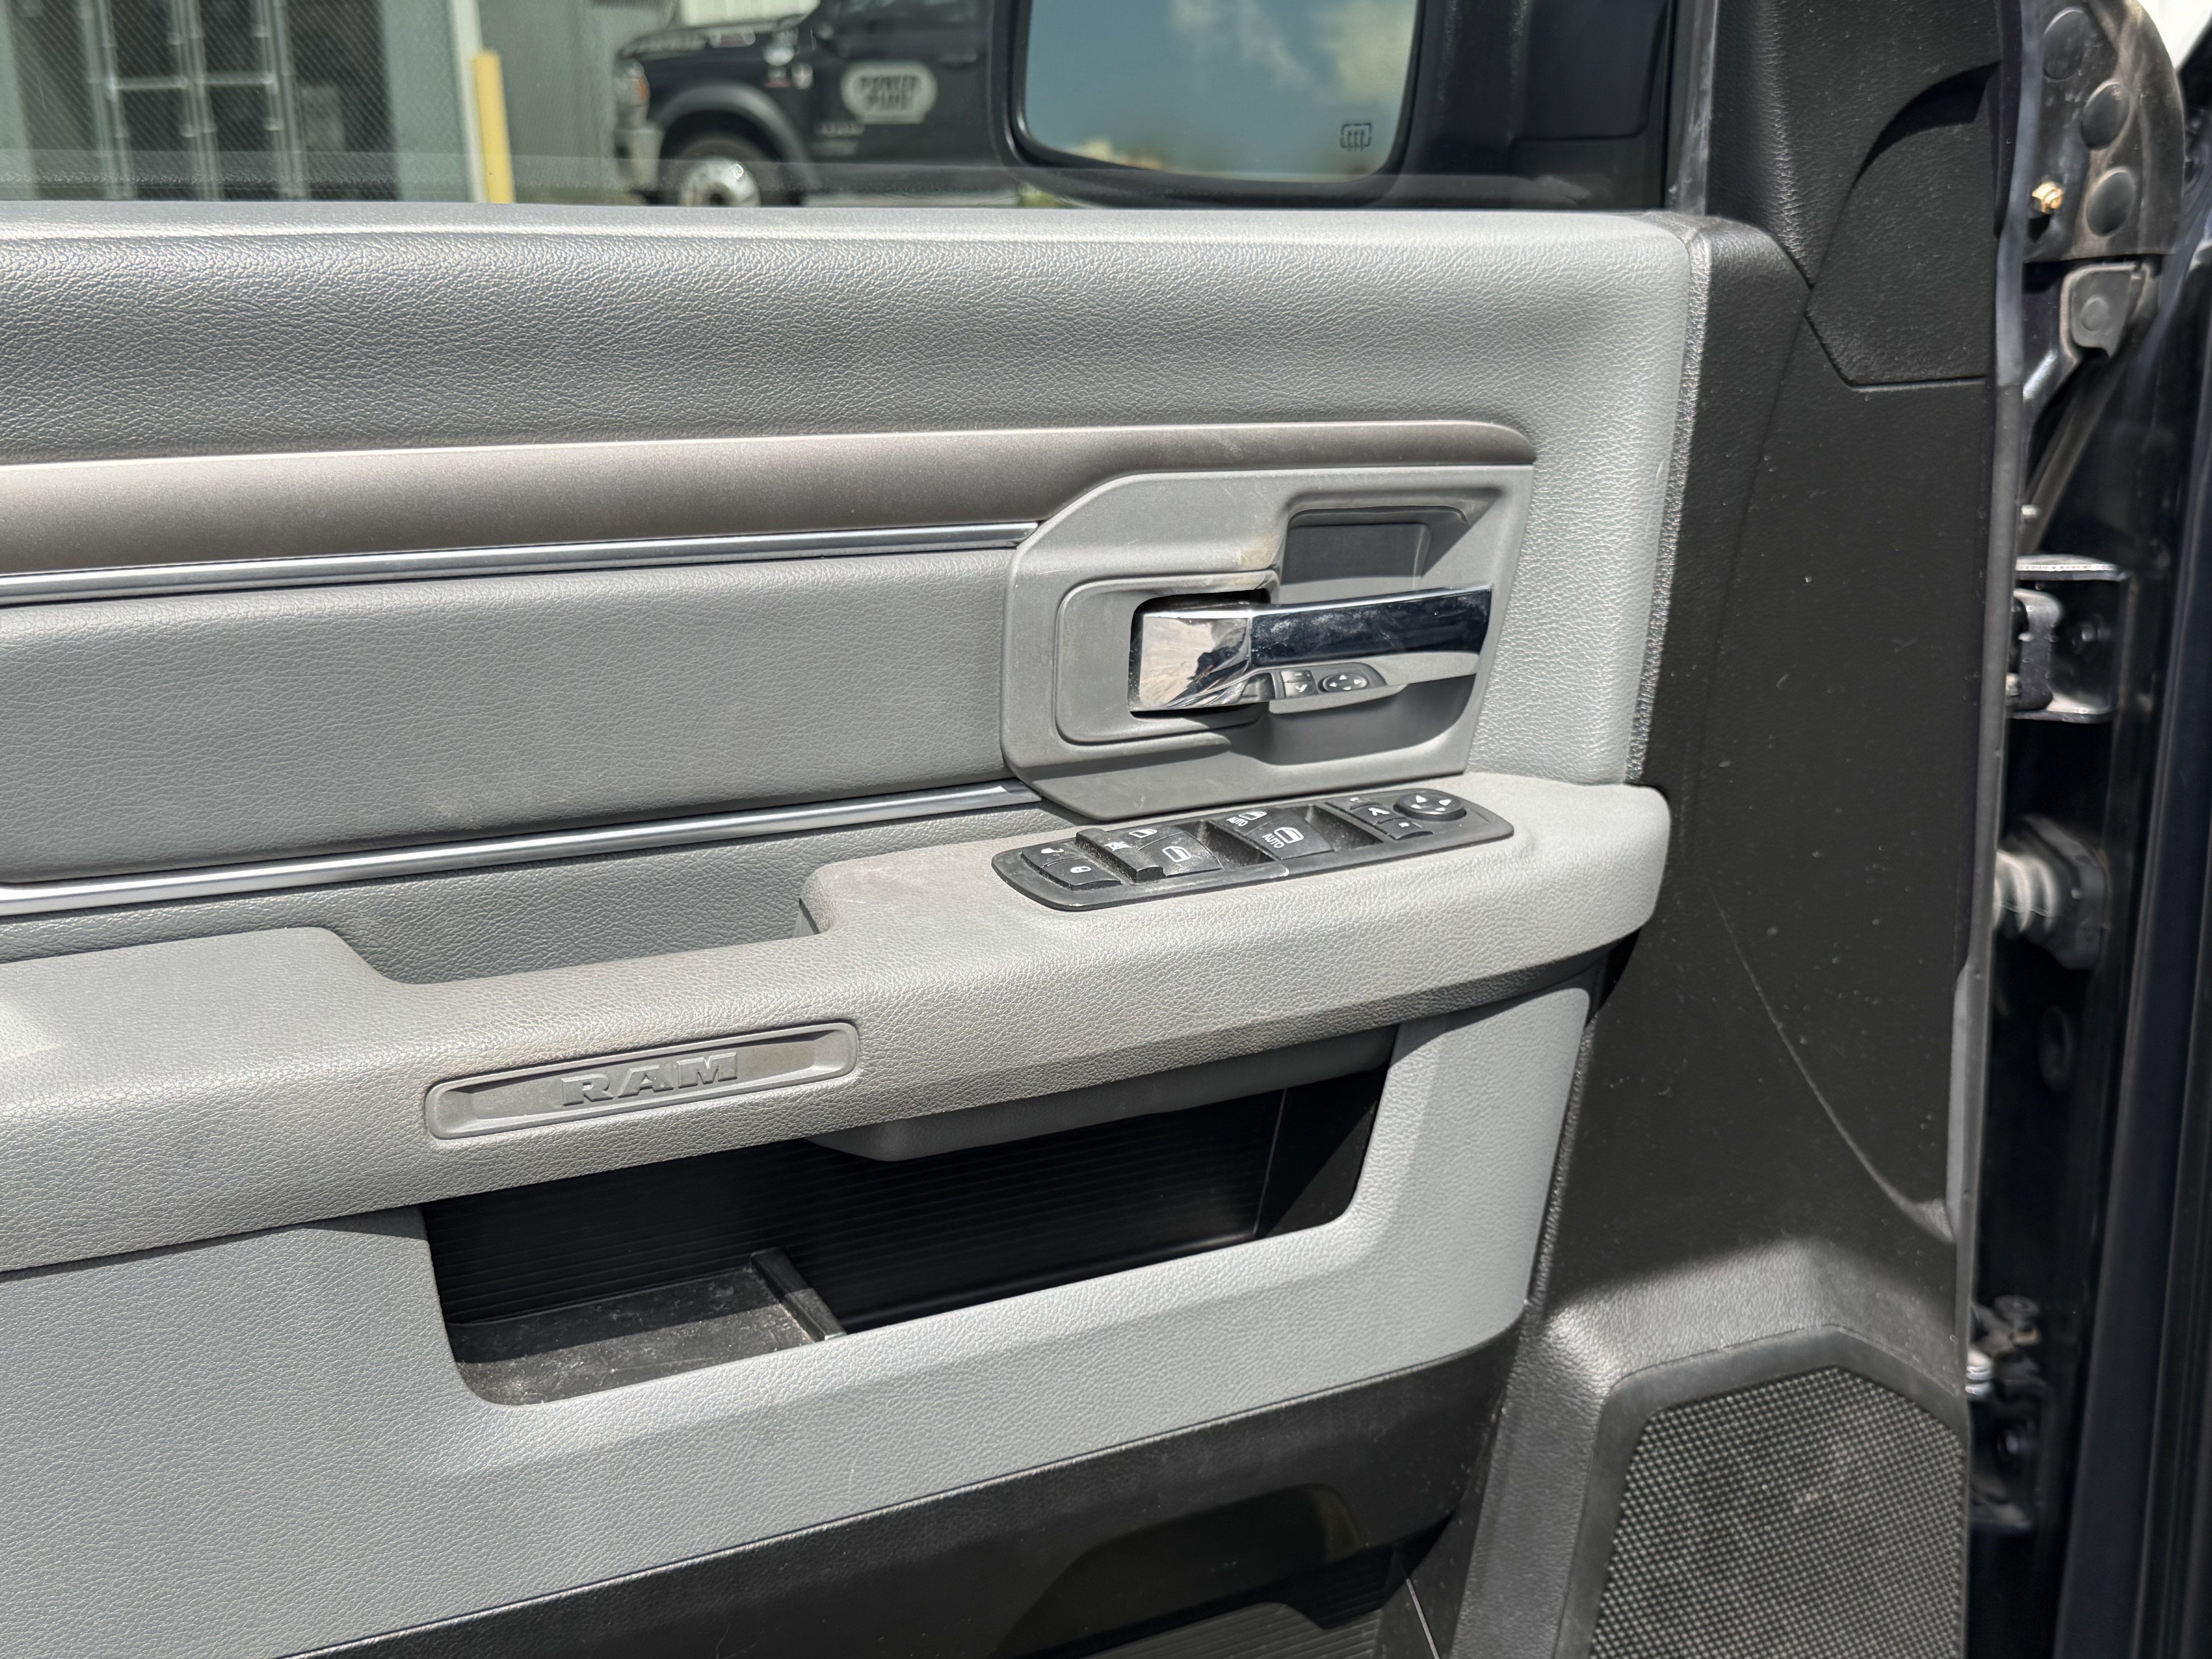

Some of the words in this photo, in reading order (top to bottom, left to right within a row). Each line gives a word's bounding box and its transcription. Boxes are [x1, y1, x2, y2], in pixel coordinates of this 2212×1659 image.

[1226, 817, 1248, 827] AUTO
[1262, 833, 1285, 848] AUTO
[561, 1052, 737, 1106] RAM
